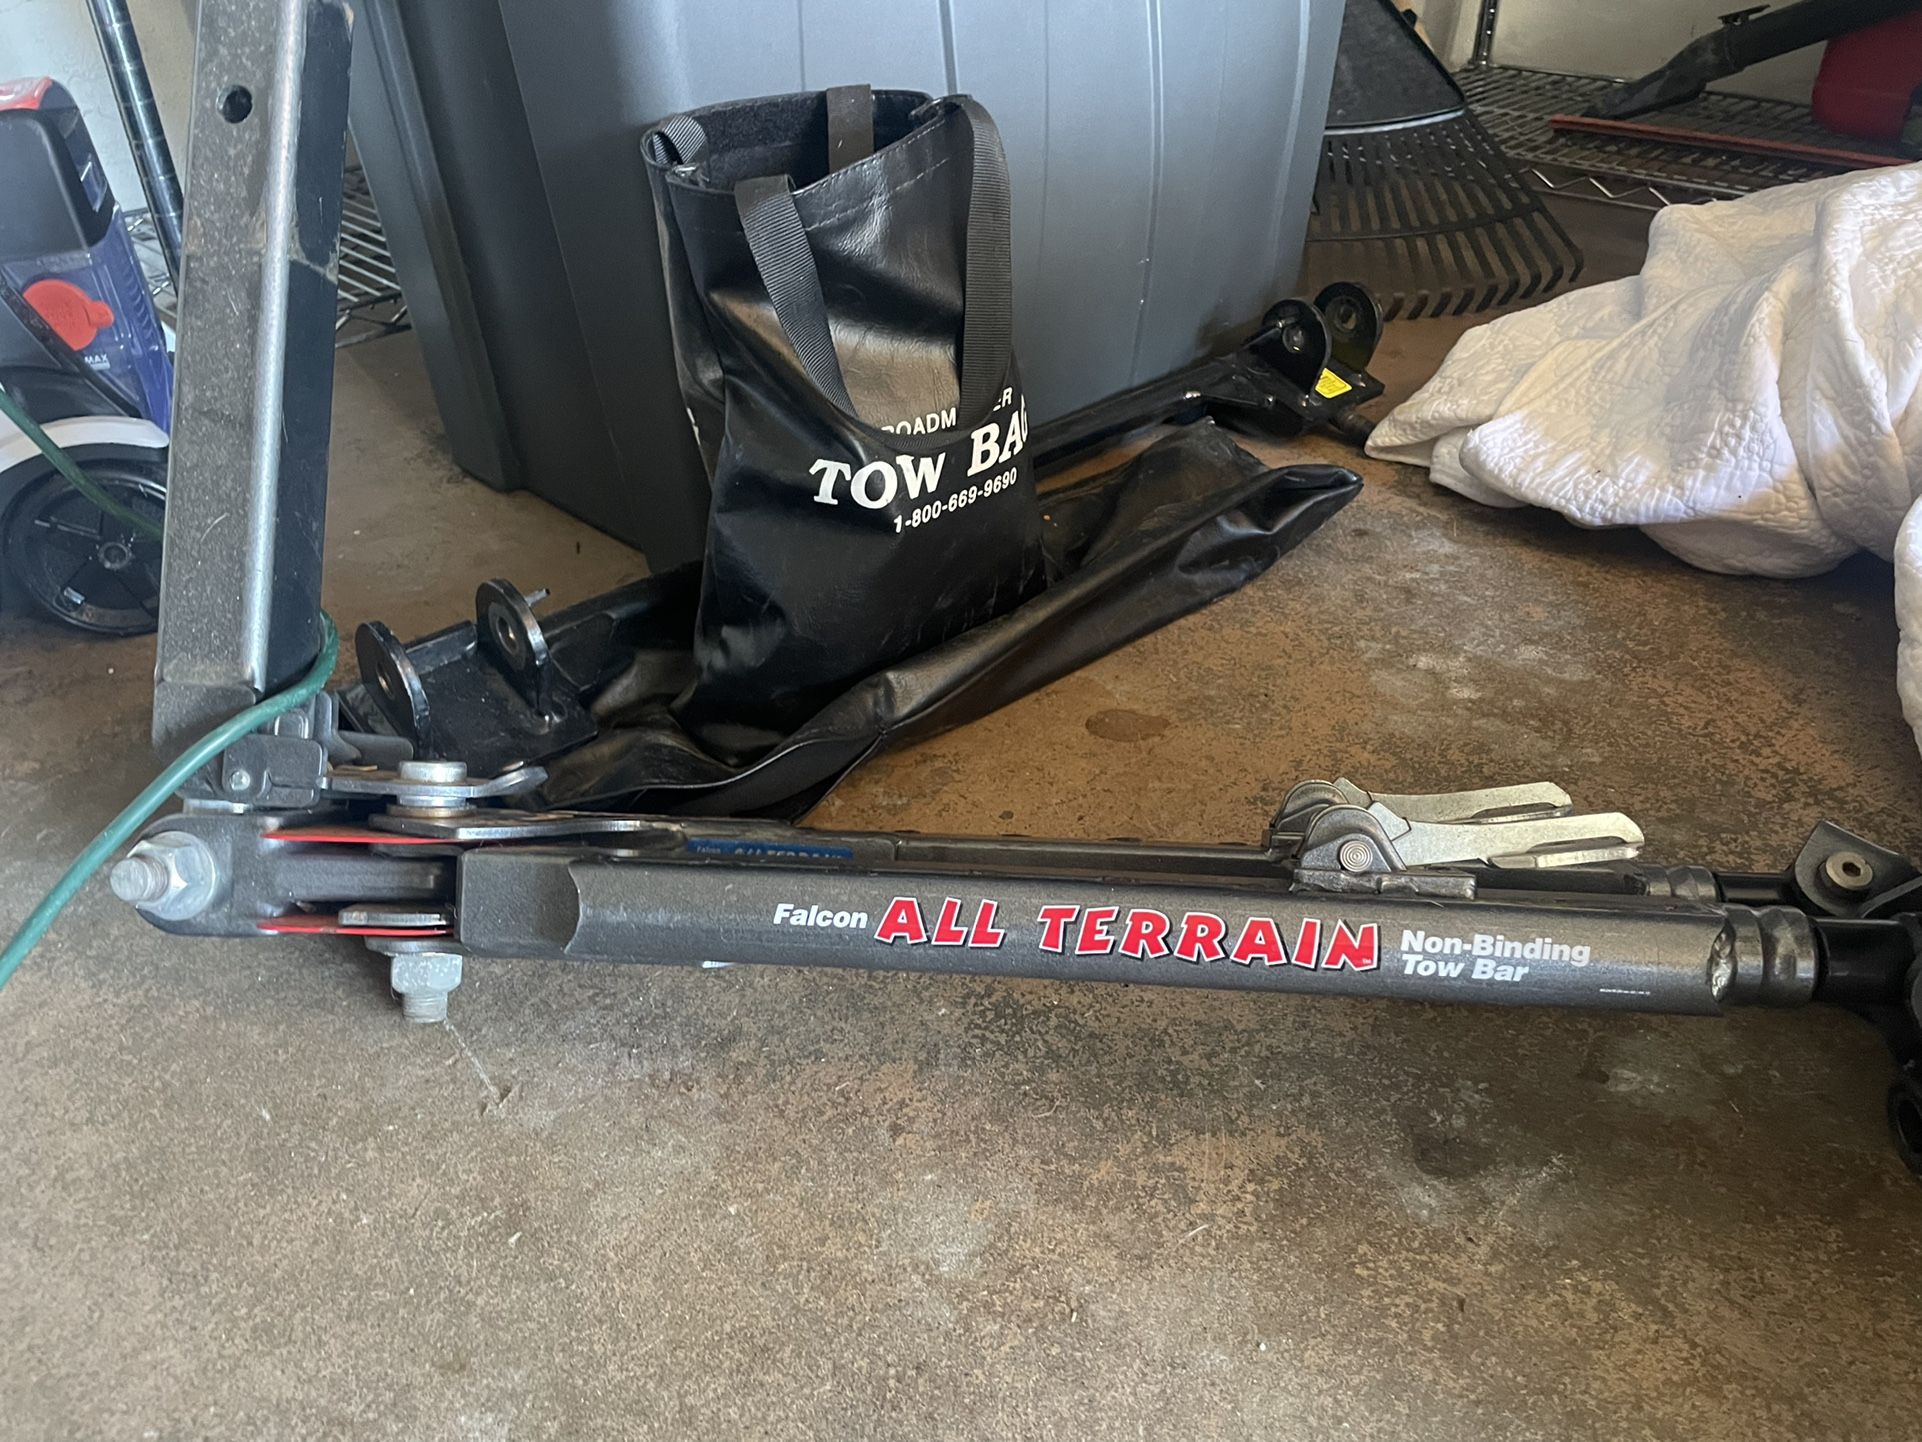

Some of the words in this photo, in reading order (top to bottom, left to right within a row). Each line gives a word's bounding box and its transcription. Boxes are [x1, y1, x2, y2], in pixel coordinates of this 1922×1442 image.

[84, 353, 108, 364] MAX
[809, 452, 947, 510] TOW
[893, 467, 1018, 533] 1-800-669-9690
[773, 903, 869, 929] Falcon
[874, 897, 1006, 949] ALL
[1037, 905, 1380, 972] TERRAIN
[1400, 929, 1591, 968] Non-Binding
[1401, 953, 1465, 979] Tow
[1471, 958, 1530, 982] Bar
